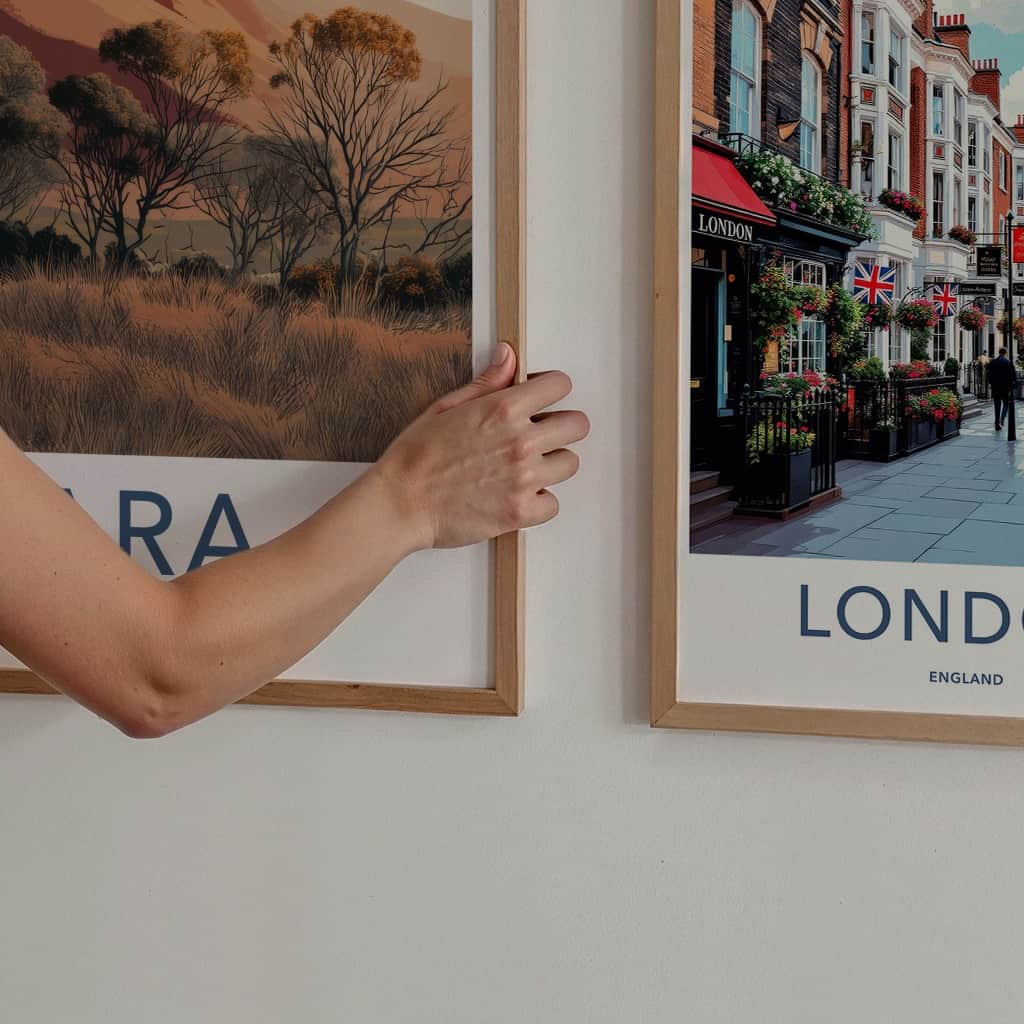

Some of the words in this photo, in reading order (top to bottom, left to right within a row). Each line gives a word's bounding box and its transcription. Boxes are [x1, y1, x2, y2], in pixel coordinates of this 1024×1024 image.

[698, 213, 753, 242] LONDON
[64, 488, 250, 576] RA
[800, 584, 1024, 645] LOND
[929, 671, 1004, 686] ENGLAND
